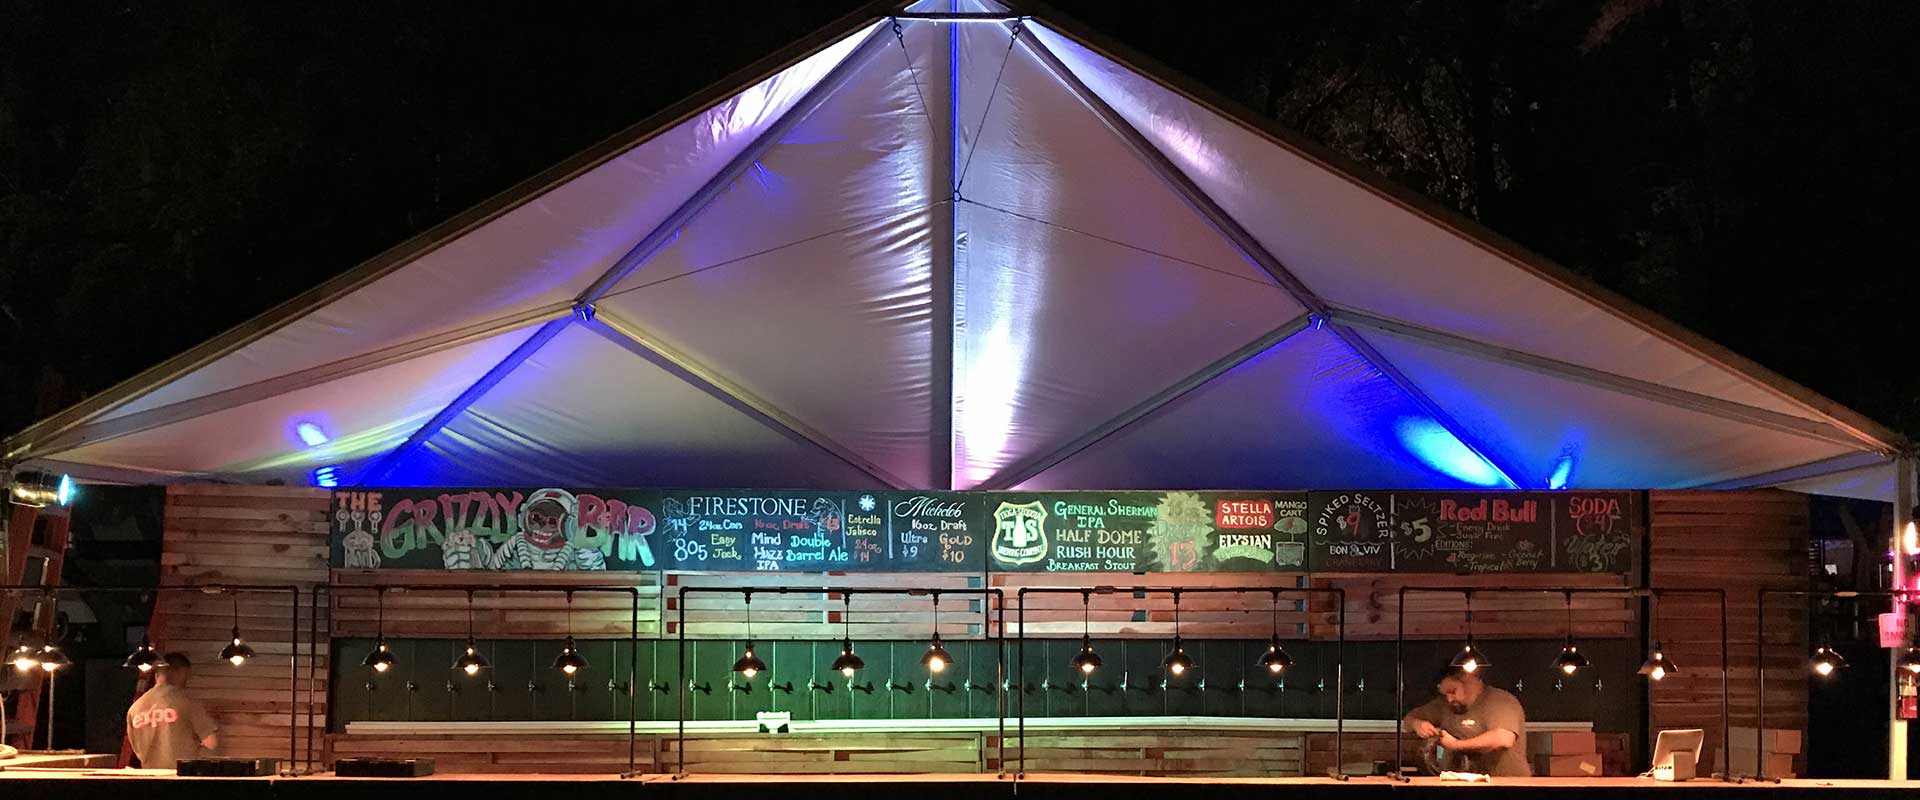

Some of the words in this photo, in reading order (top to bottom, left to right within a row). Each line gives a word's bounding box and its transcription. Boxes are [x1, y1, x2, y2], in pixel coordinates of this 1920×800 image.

[335, 492, 383, 511] THE
[689, 497, 808, 516] FIRESTONE
[893, 495, 966, 518] Michelob
[1222, 503, 1272, 514] STELLA
[1275, 500, 1307, 510] MANGO
[1568, 496, 1621, 515] SODA
[1280, 509, 1303, 518] CART
[1316, 494, 1349, 536] SPIKED
[1354, 493, 1389, 539] SELTZER
[1440, 499, 1487, 522] Red
[1492, 499, 1537, 522] Bull
[381, 491, 524, 559] GRIZZLY
[847, 513, 882, 526] Estrella
[940, 519, 967, 531] Draft
[1077, 516, 1105, 528] IPA
[1221, 515, 1268, 527] ARTOIS
[576, 494, 656, 567] BAR
[845, 524, 878, 537] Jalisco
[1055, 529, 1092, 542] HALF
[1098, 530, 1142, 544] DOME
[1401, 516, 1432, 543] $5
[751, 532, 782, 546] Mind
[790, 532, 832, 548] Double
[900, 532, 928, 544] Ultra
[1219, 534, 1272, 550] ELYSIAN
[674, 537, 708, 562] 805
[785, 548, 825, 562] Barrel
[828, 548, 849, 562] Ale
[902, 546, 918, 558] $9
[941, 550, 965, 563] $10
[1056, 545, 1092, 559] RUSH
[1096, 545, 1136, 559] HOUR
[1329, 545, 1349, 556] BON
[1363, 545, 1381, 555] VIV
[756, 560, 780, 571] IPA
[132, 704, 178, 729] expo
